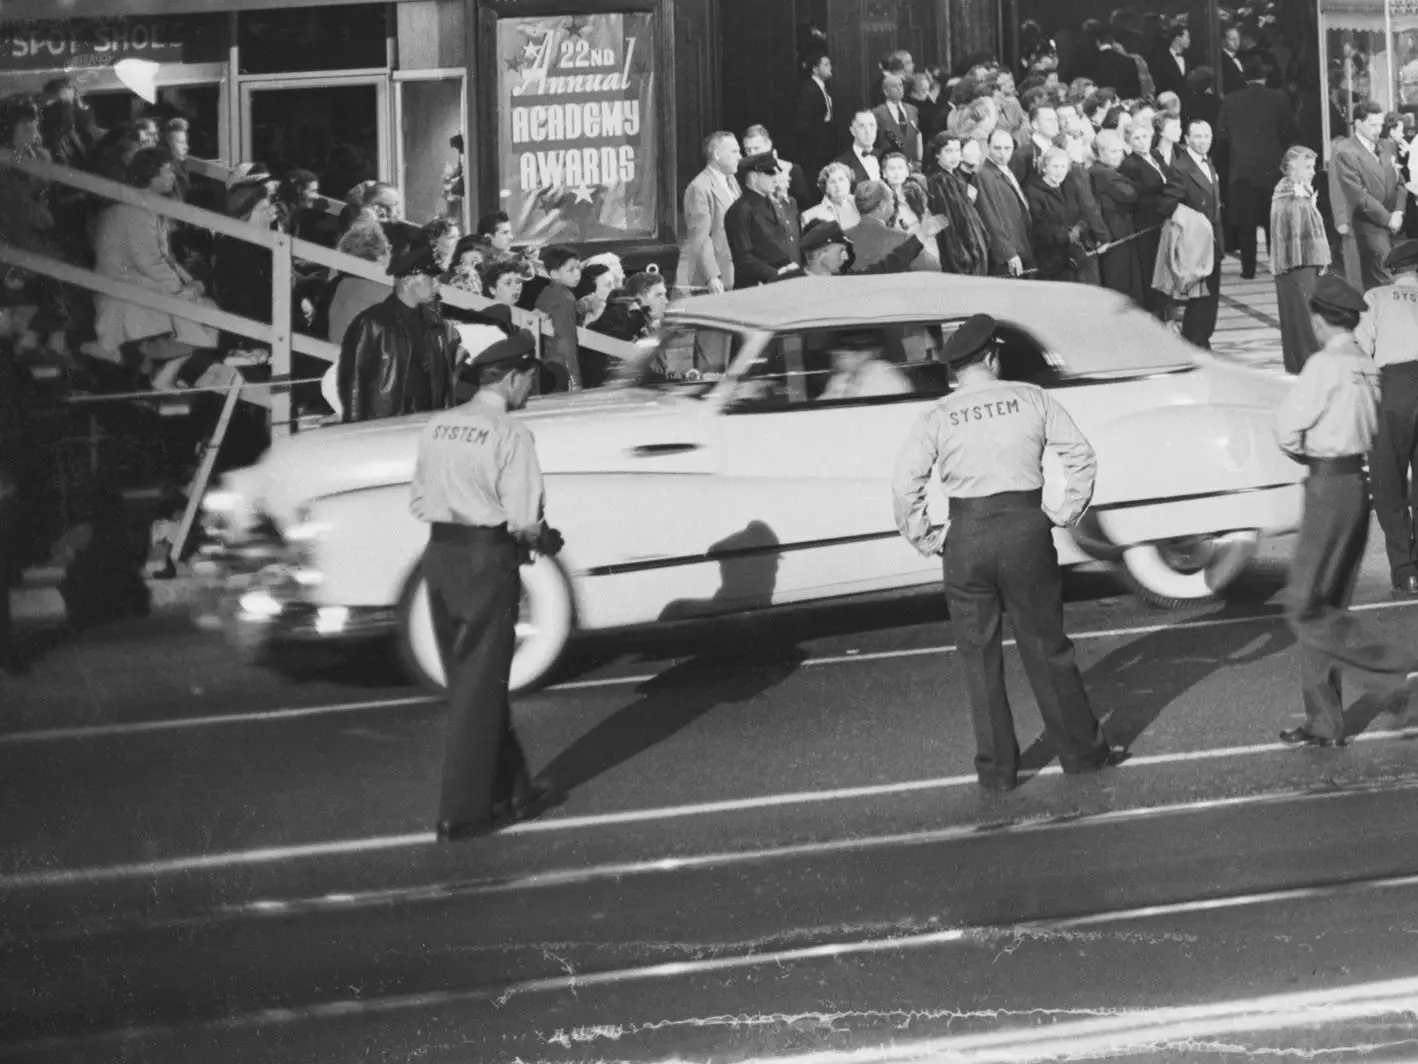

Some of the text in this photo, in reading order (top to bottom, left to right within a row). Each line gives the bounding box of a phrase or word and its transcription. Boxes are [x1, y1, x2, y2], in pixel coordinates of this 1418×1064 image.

[512, 30, 636, 97] Annual
[561, 39, 615, 68] 22ND
[512, 100, 640, 144] ACADEMY
[520, 145, 635, 190] AWARDS
[948, 398, 1022, 427] SYSTEM
[432, 423, 490, 447] SYSTEM
